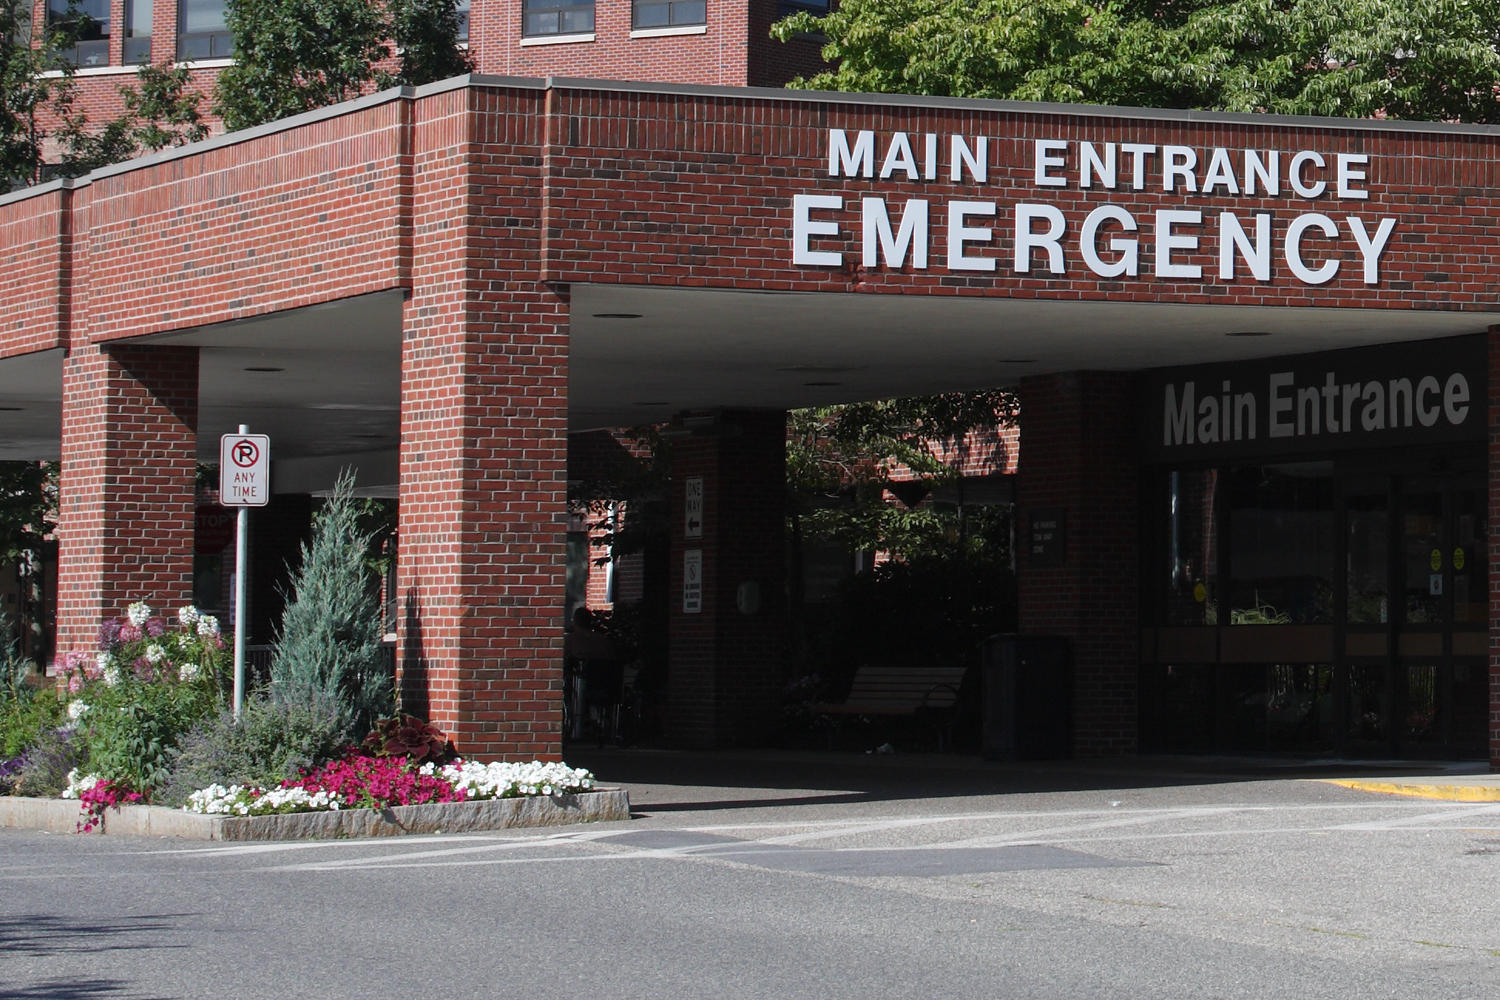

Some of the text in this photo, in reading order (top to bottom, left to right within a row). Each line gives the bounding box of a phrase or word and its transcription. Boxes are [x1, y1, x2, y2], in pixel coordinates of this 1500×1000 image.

[828, 128, 1370, 199] MAIN ENTRANCE
[792, 194, 1397, 285] EMERGENCY
[1163, 371, 1470, 446] Main Entrance
[234, 472, 255, 483] ANY
[232, 486, 257, 497] TIME
[688, 482, 701, 496] ONE
[687, 499, 701, 513] WAY
